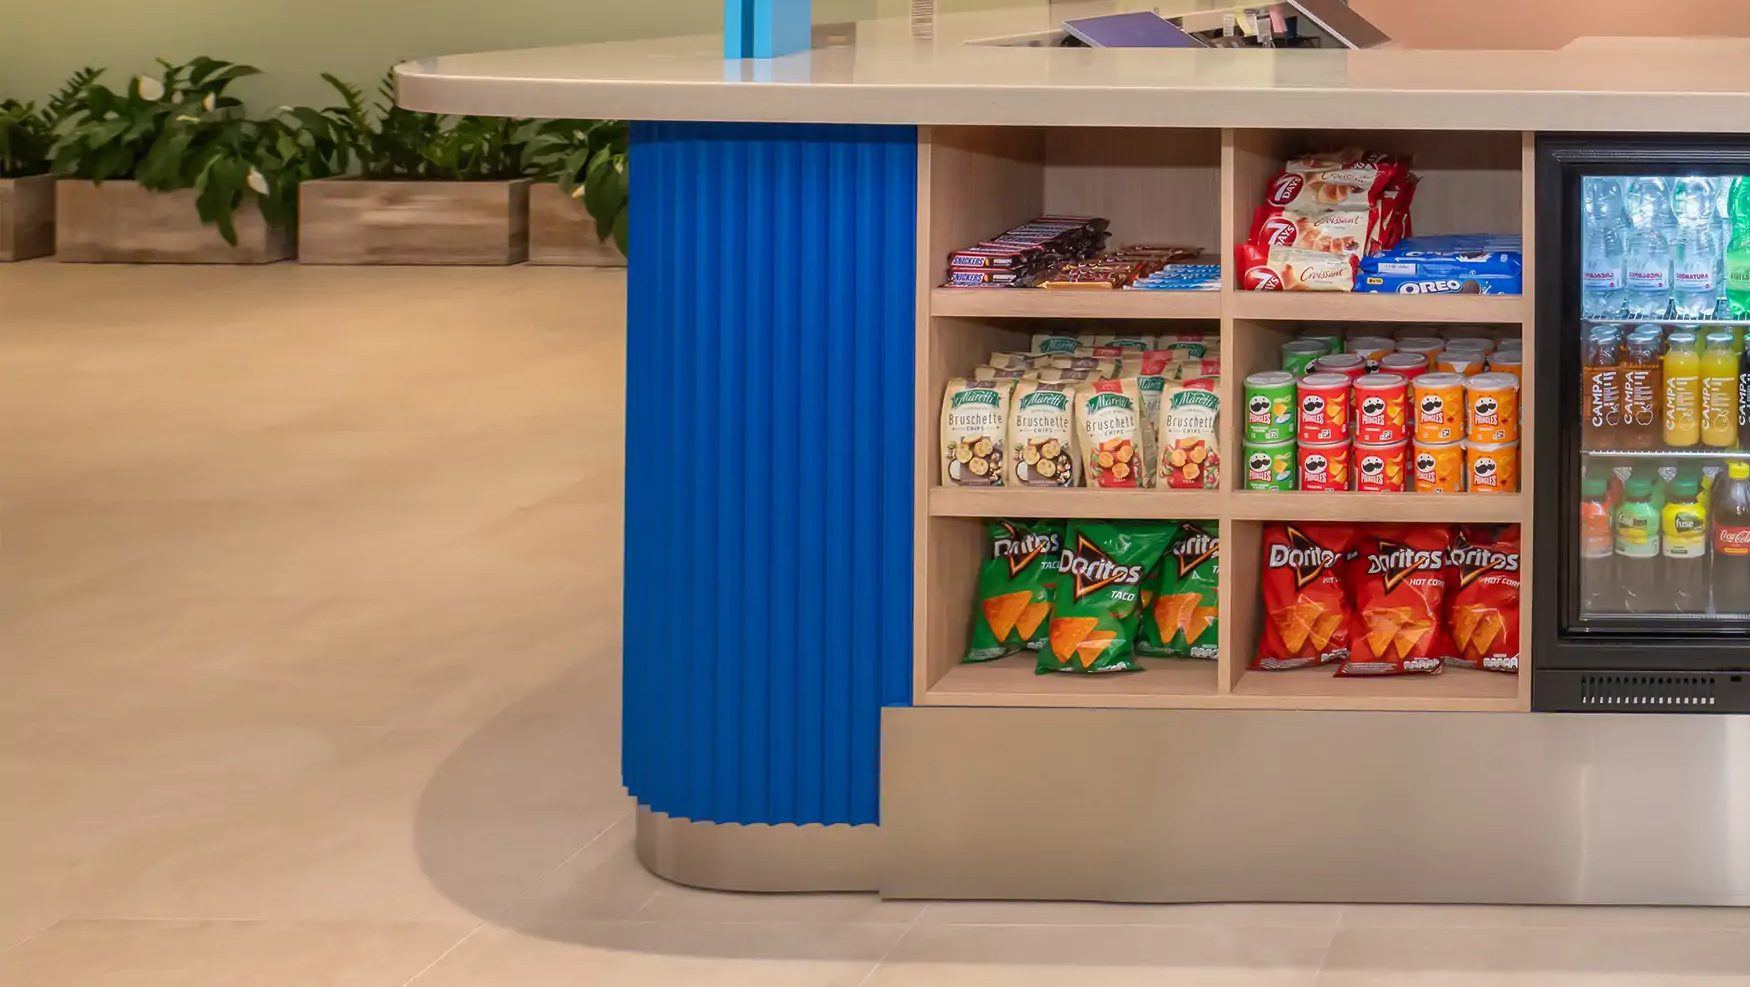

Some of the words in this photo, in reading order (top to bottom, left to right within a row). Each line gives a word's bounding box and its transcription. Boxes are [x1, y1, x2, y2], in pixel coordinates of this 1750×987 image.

[1282, 176, 1302, 200] DAYS
[953, 256, 985, 266] SNICKERS
[1300, 266, 1345, 282] Croissant
[1400, 279, 1461, 294] OREO
[1592, 373, 1602, 427] CAMPA
[1623, 371, 1633, 425] CAMPA
[1666, 377, 1675, 431] CAMPA
[1701, 377, 1711, 430] CAMPA
[1738, 373, 1747, 426] CAMPA
[948, 413, 1003, 426] Bruschette
[1016, 414, 1070, 428] Bruschette
[1086, 414, 1135, 432] Bruschett
[1166, 414, 1213, 428] Bruschett
[1675, 517, 1694, 530] fuse
[1059, 548, 1143, 584] Doritos
[1367, 550, 1443, 575] Doritos
[1447, 544, 1519, 571] oritos
[1410, 578, 1426, 586] HOT
[1483, 576, 1500, 585] HOT
[1110, 590, 1135, 601] TACO
